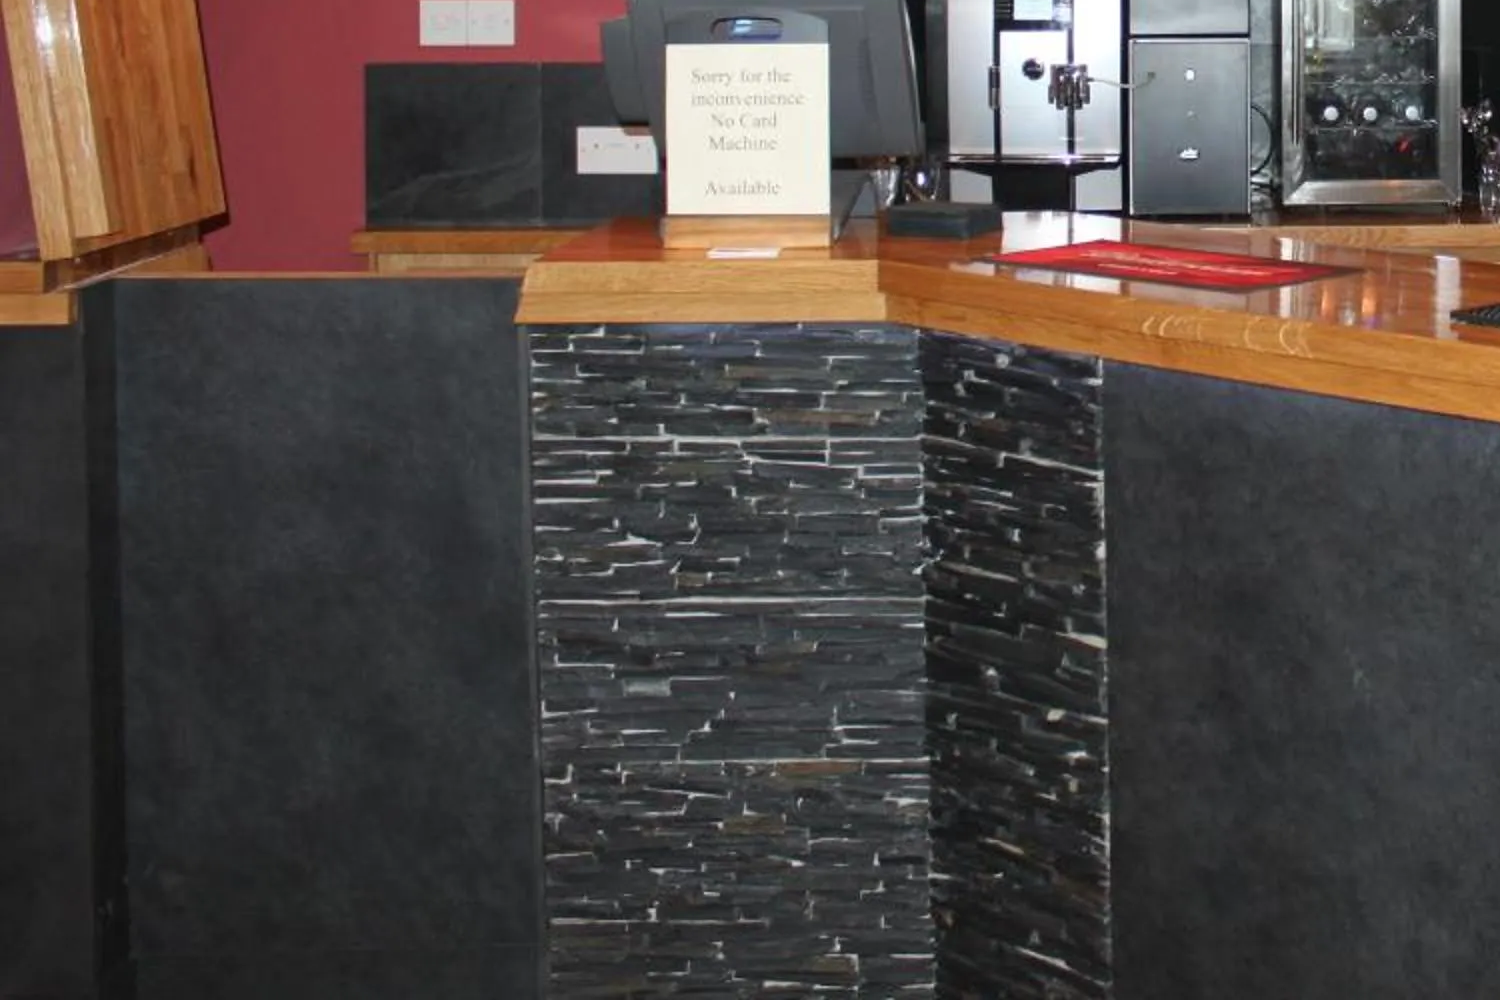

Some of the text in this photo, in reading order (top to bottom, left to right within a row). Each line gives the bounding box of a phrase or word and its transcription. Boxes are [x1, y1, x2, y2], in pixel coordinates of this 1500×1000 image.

[690, 68, 792, 86] Sorry for the
[690, 92, 807, 107] inconvenience
[711, 112, 777, 128] No Card
[708, 135, 778, 151] Machine
[704, 180, 782, 196] Available
